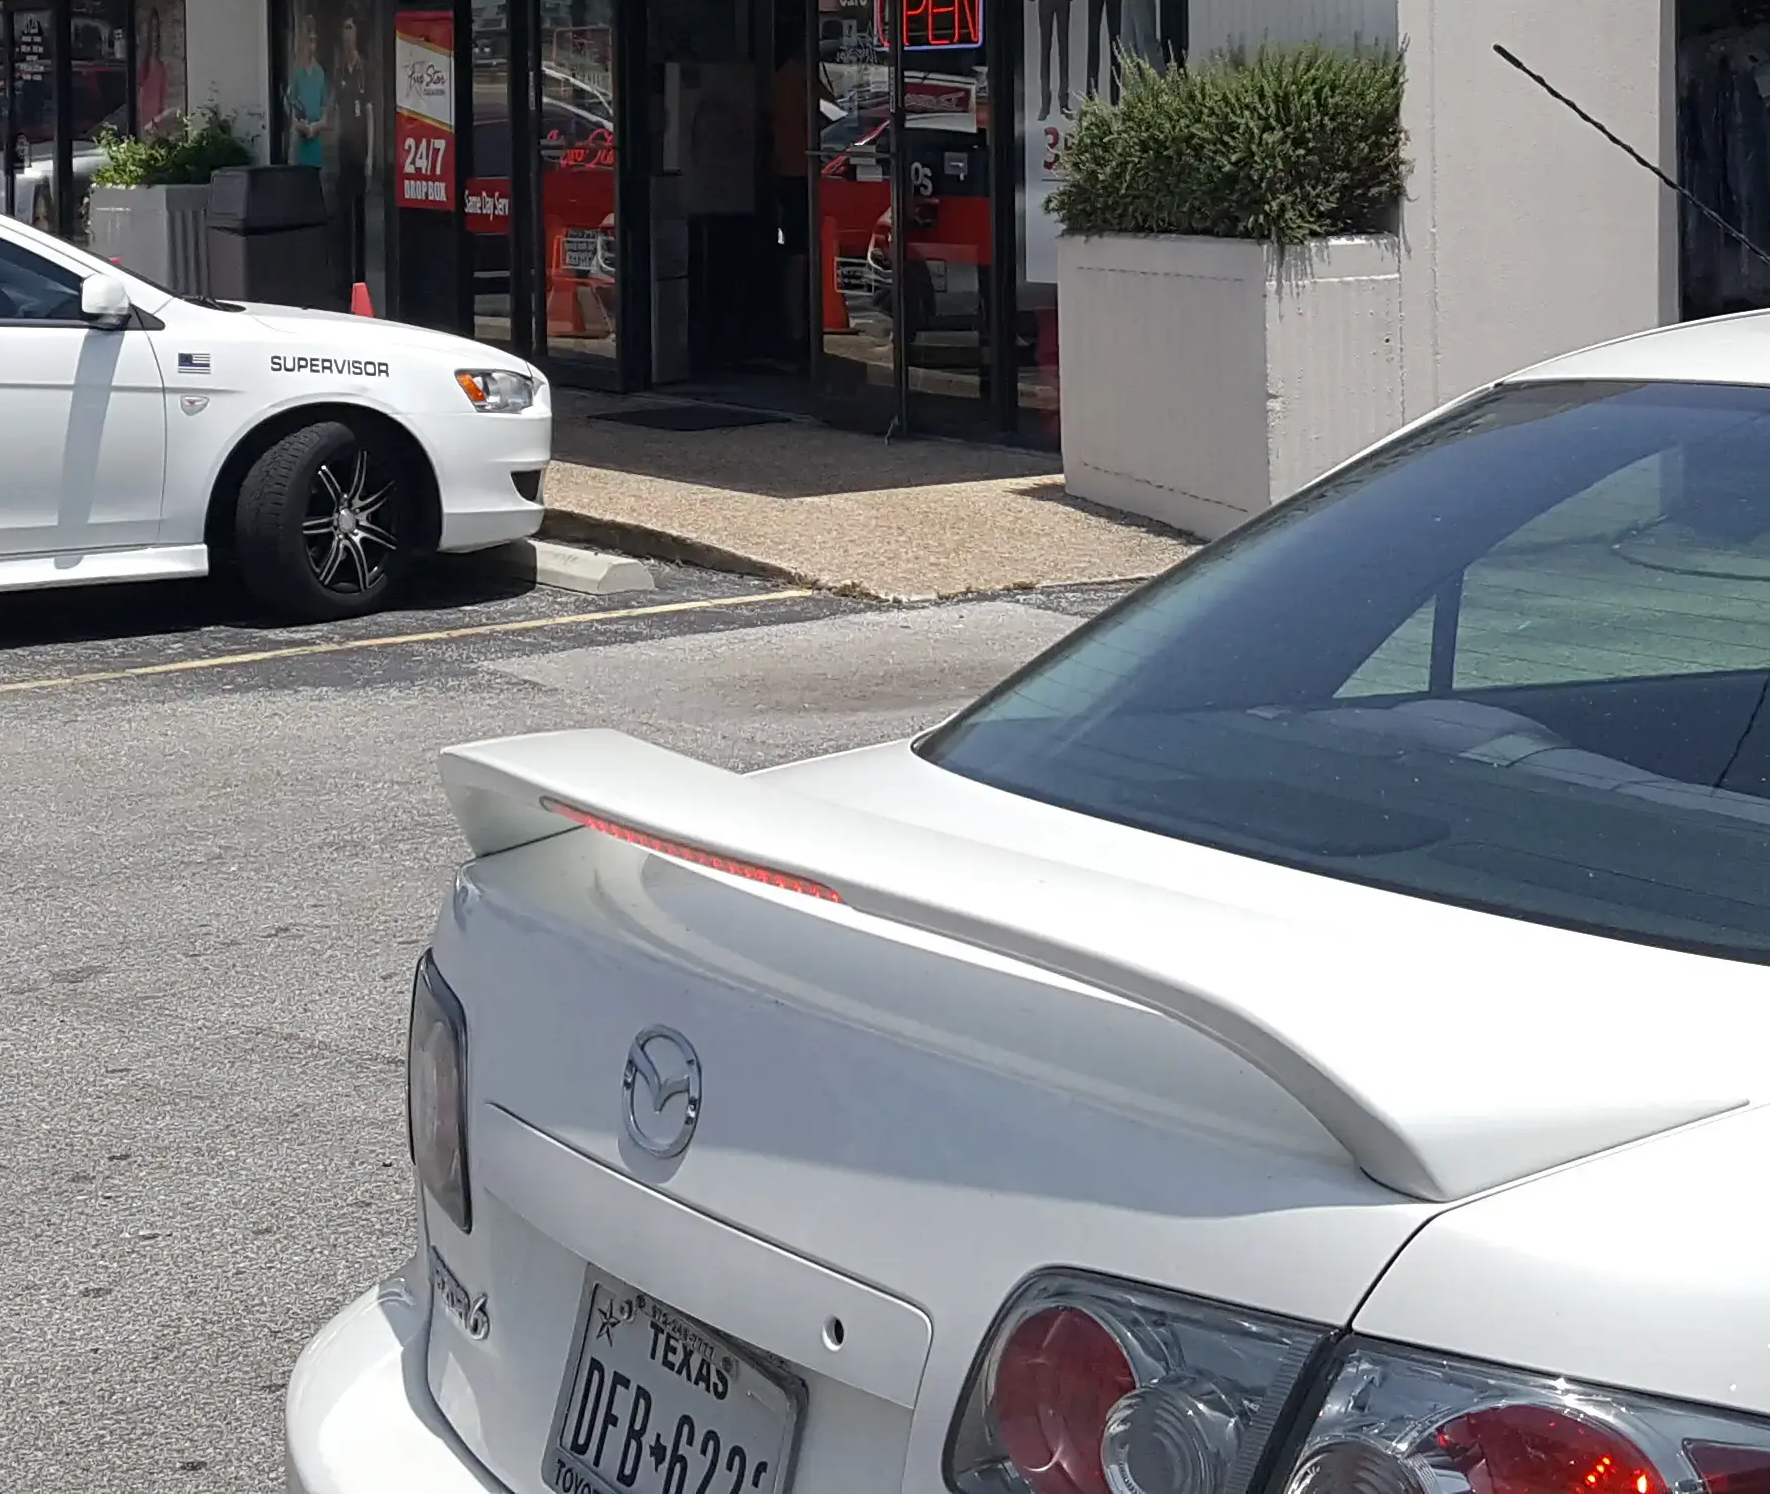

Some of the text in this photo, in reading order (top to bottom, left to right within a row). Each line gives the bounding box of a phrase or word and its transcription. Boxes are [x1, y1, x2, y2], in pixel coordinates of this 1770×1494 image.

[404, 137, 447, 175] 24/7
[404, 180, 447, 202] DROP BOX
[270, 355, 390, 378] SUPERVISOR
[649, 1320, 729, 1401] TEXAS
[570, 1357, 653, 1488] DFB
